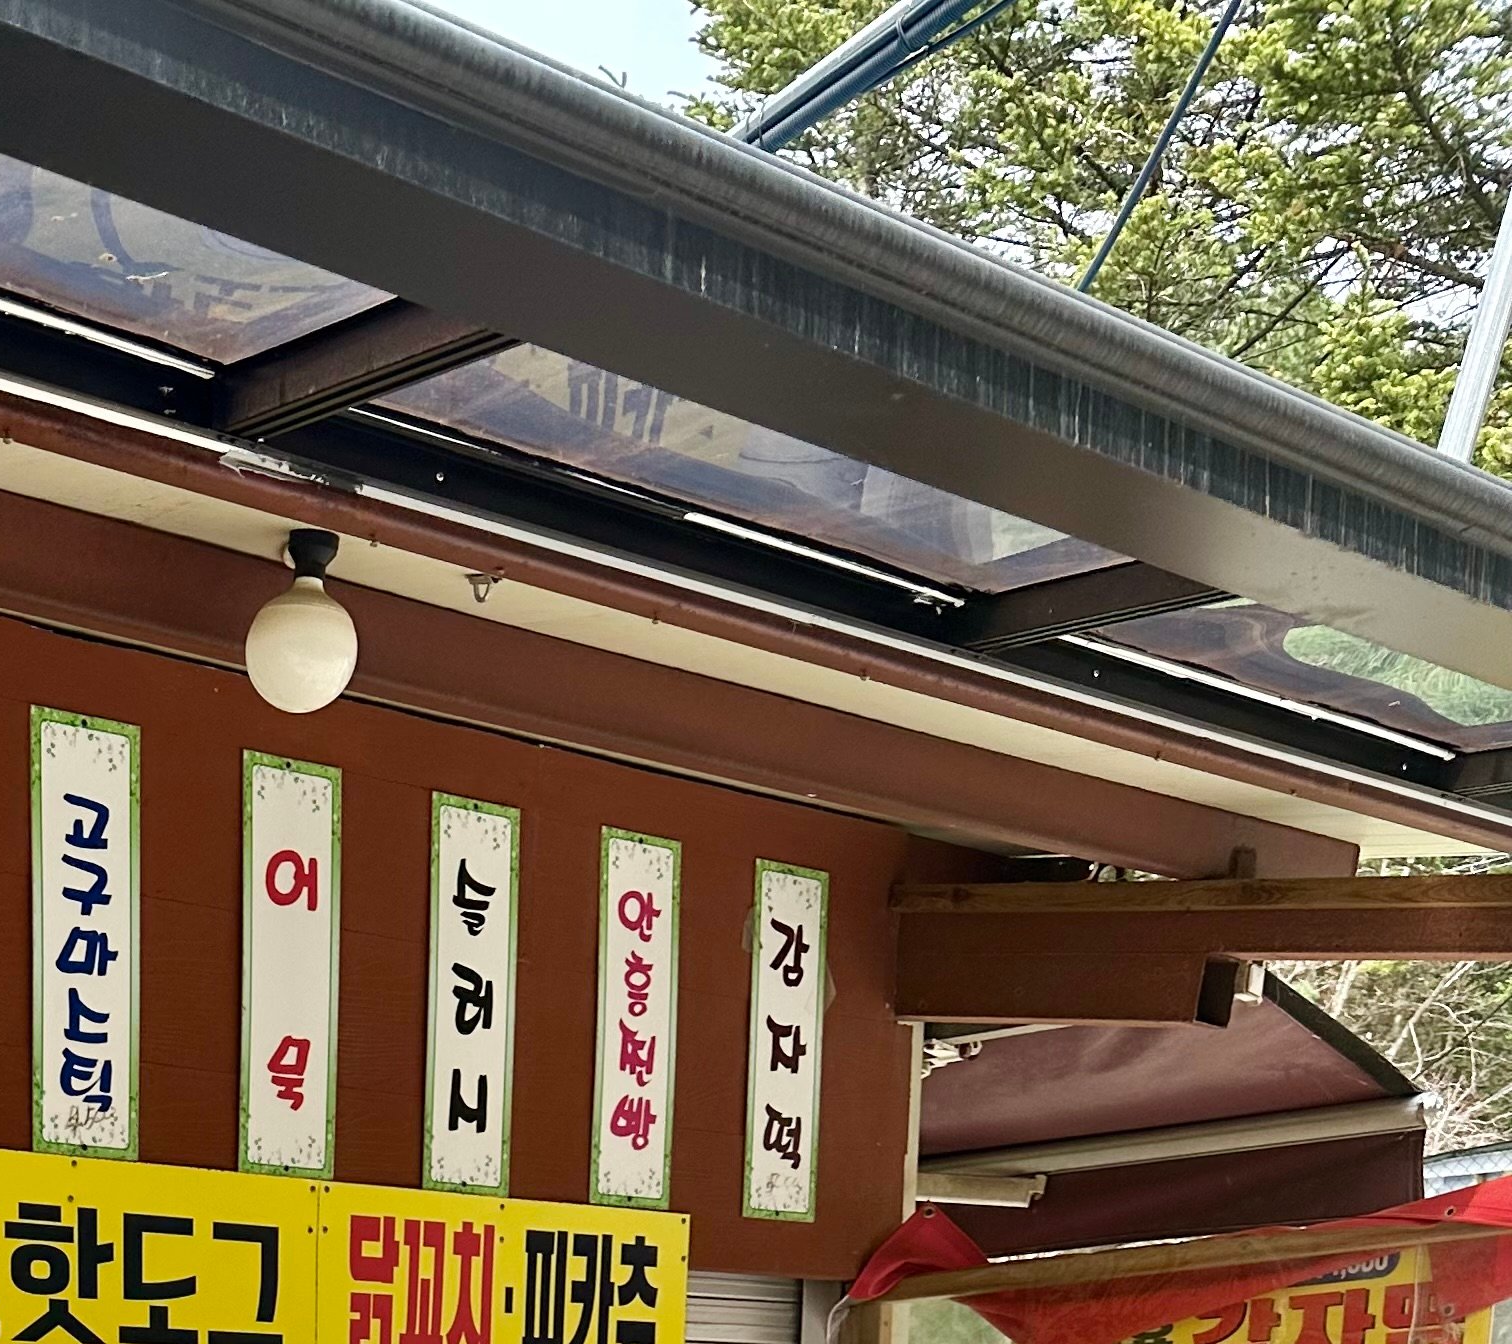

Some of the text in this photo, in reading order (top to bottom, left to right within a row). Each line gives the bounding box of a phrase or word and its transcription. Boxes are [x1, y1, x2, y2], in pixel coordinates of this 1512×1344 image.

[55, 792, 119, 1114] 고구마스틱
[265, 849, 318, 1111] 어묵
[610, 890, 662, 1151] 안흥찐빵
[763, 917, 810, 1170] 감자떡
